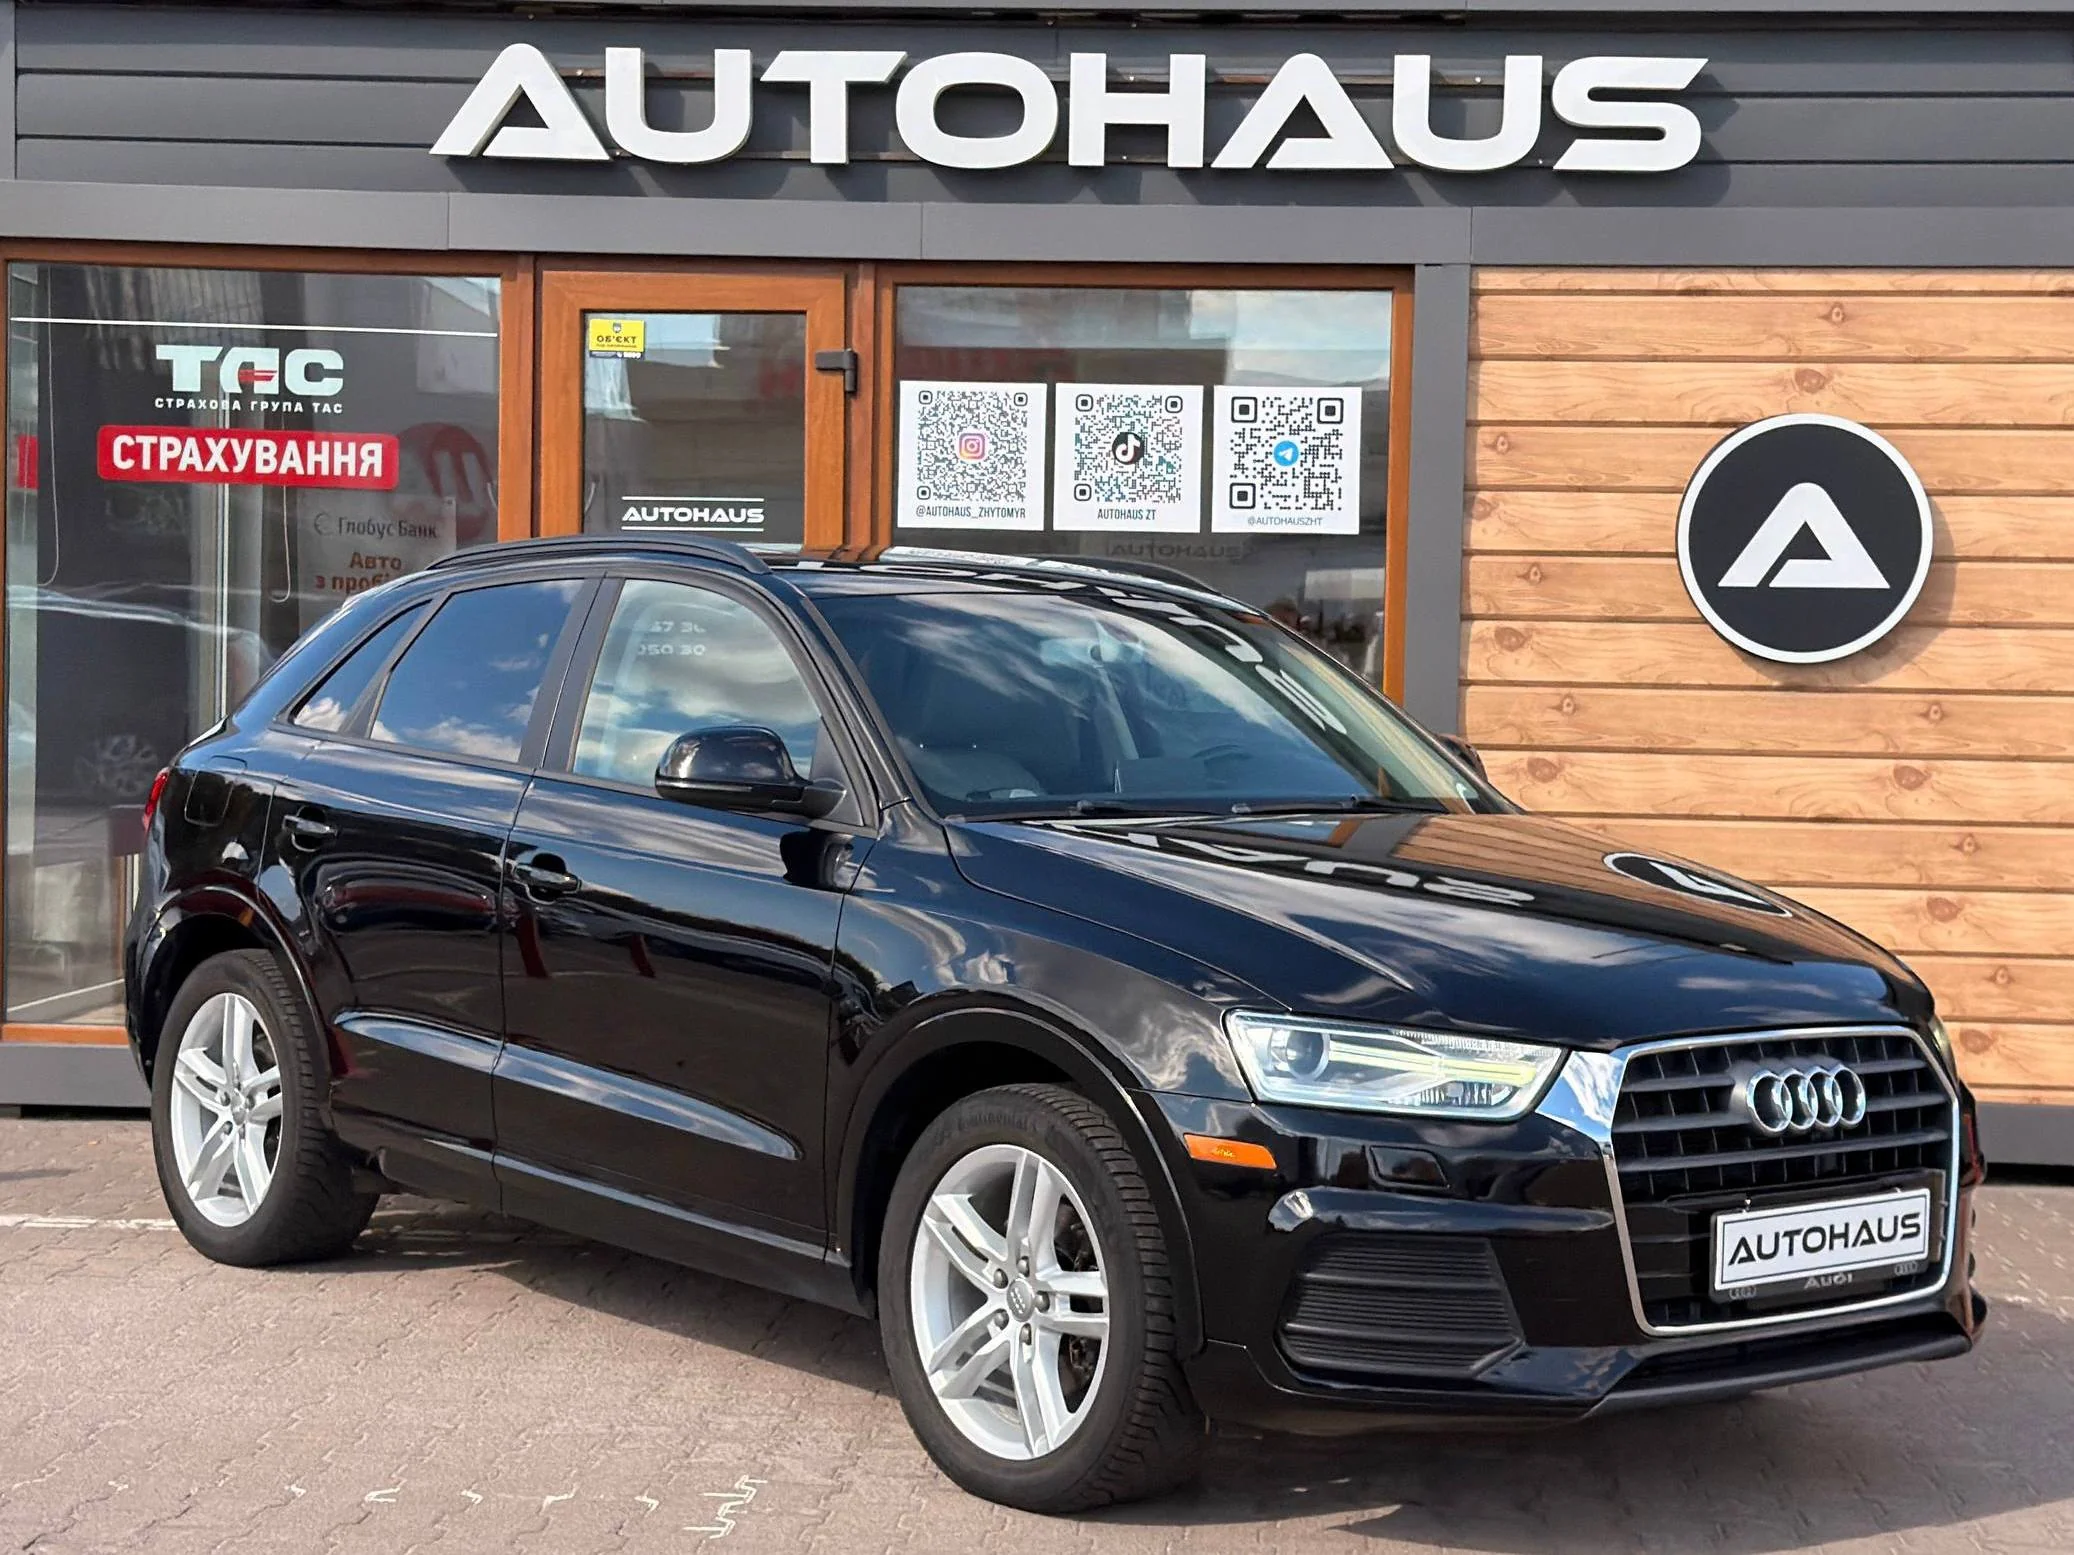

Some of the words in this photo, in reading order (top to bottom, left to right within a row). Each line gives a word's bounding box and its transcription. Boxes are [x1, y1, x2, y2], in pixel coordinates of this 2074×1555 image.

[428, 43, 1709, 172] AUTOHAUS
[154, 397, 242, 412] СТРАХОВА
[250, 400, 304, 413] ГРУПА
[312, 402, 344, 414] ТАС
[111, 433, 383, 478] СТРАХУВАННЯ
[621, 506, 765, 524] AUTOHAUS
[915, 504, 1026, 519] @AUTOHAUS_ZHYTOMYR
[1097, 508, 1144, 520] AUTOHAUS
[1145, 509, 1157, 521] ZT
[338, 516, 395, 539] Глобус
[397, 519, 438, 538] Банк
[1247, 516, 1323, 527] @AUTOHAUSZHT
[350, 552, 402, 571] Авто
[1728, 1213, 1921, 1266] AUTOHAUS
[1803, 1272, 1853, 1290] Audi
